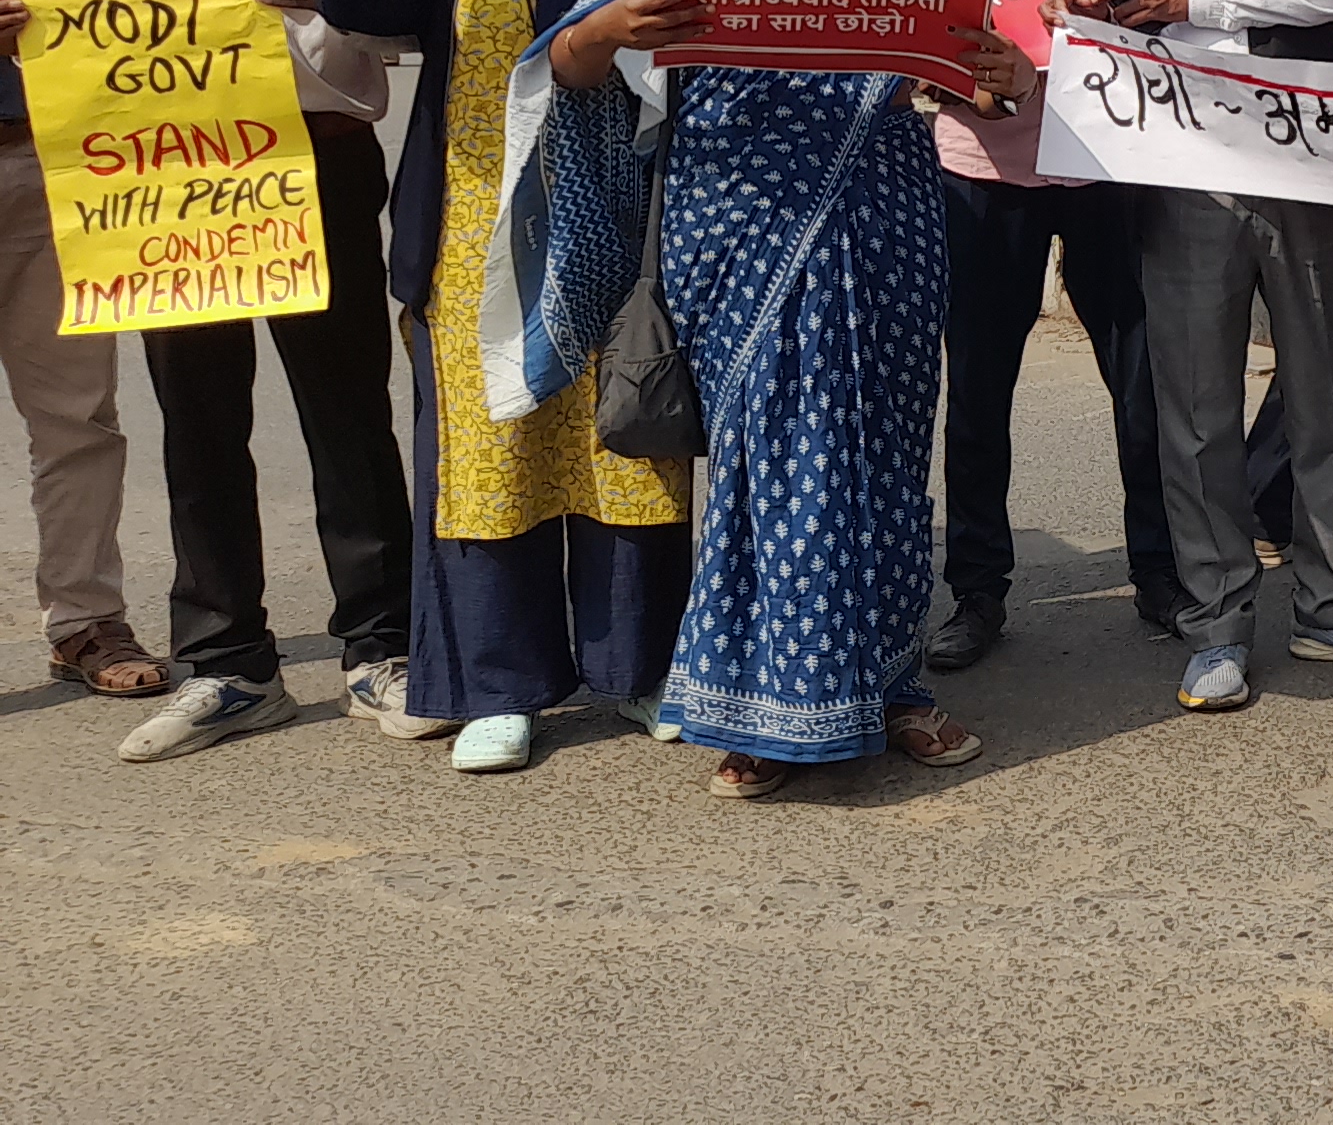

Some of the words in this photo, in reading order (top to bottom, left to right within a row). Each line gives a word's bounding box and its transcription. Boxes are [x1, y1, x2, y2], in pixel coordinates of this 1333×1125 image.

[720, 13, 761, 32] का
[769, 13, 827, 33] साथ
[105, 43, 251, 94] GOVT
[82, 119, 278, 176] STAND
[75, 185, 163, 234] WITH
[178, 169, 305, 221] PEACE
[139, 207, 312, 267] CONDEMN
[68, 249, 321, 327] IMPERIALISM
